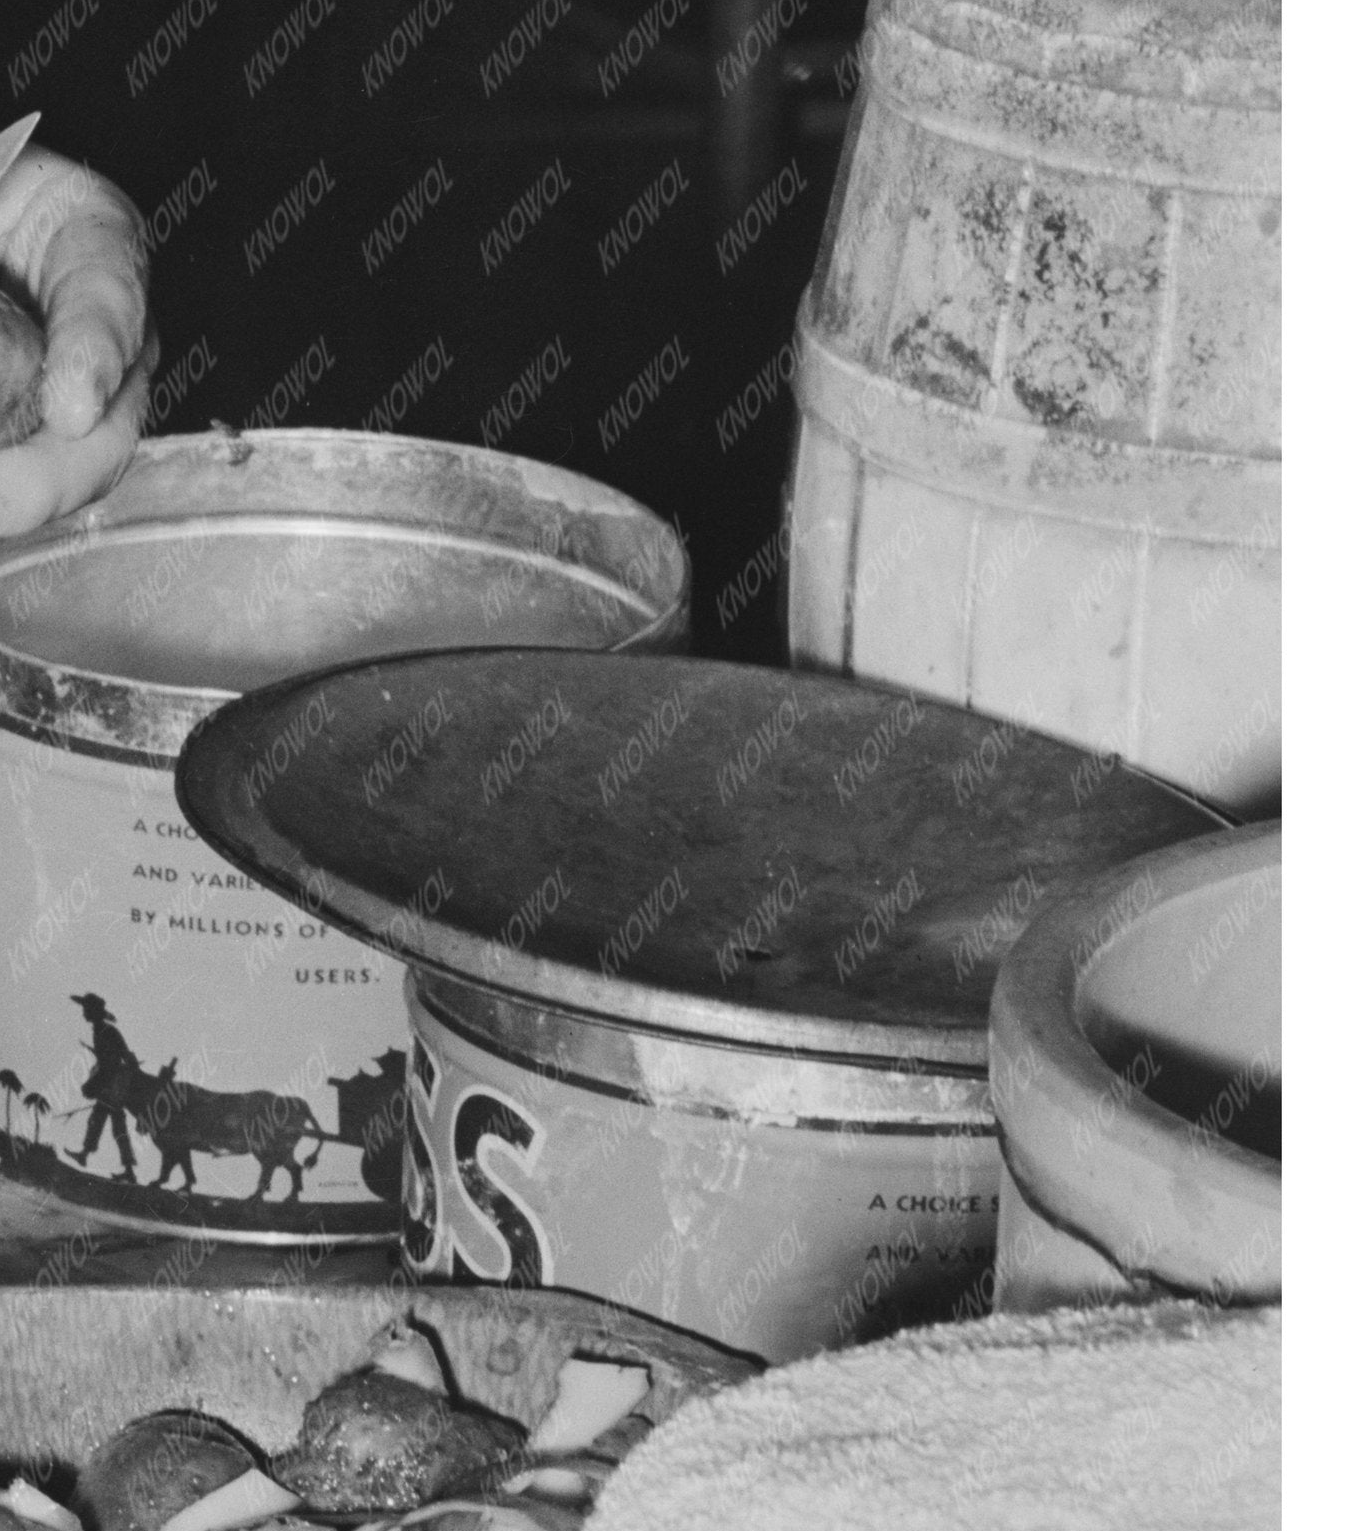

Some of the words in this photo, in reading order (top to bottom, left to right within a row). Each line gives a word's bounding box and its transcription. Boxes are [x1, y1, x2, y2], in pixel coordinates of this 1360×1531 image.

[133, 818, 148, 834] A
[132, 863, 178, 884] AND
[130, 907, 157, 925] BY
[168, 915, 285, 939] MILLIONS
[298, 924, 330, 940] OF
[295, 967, 382, 985] USERS.
[867, 1193, 887, 1211] A
[895, 1194, 982, 1214] CHOICE
[865, 1245, 920, 1264] AND
